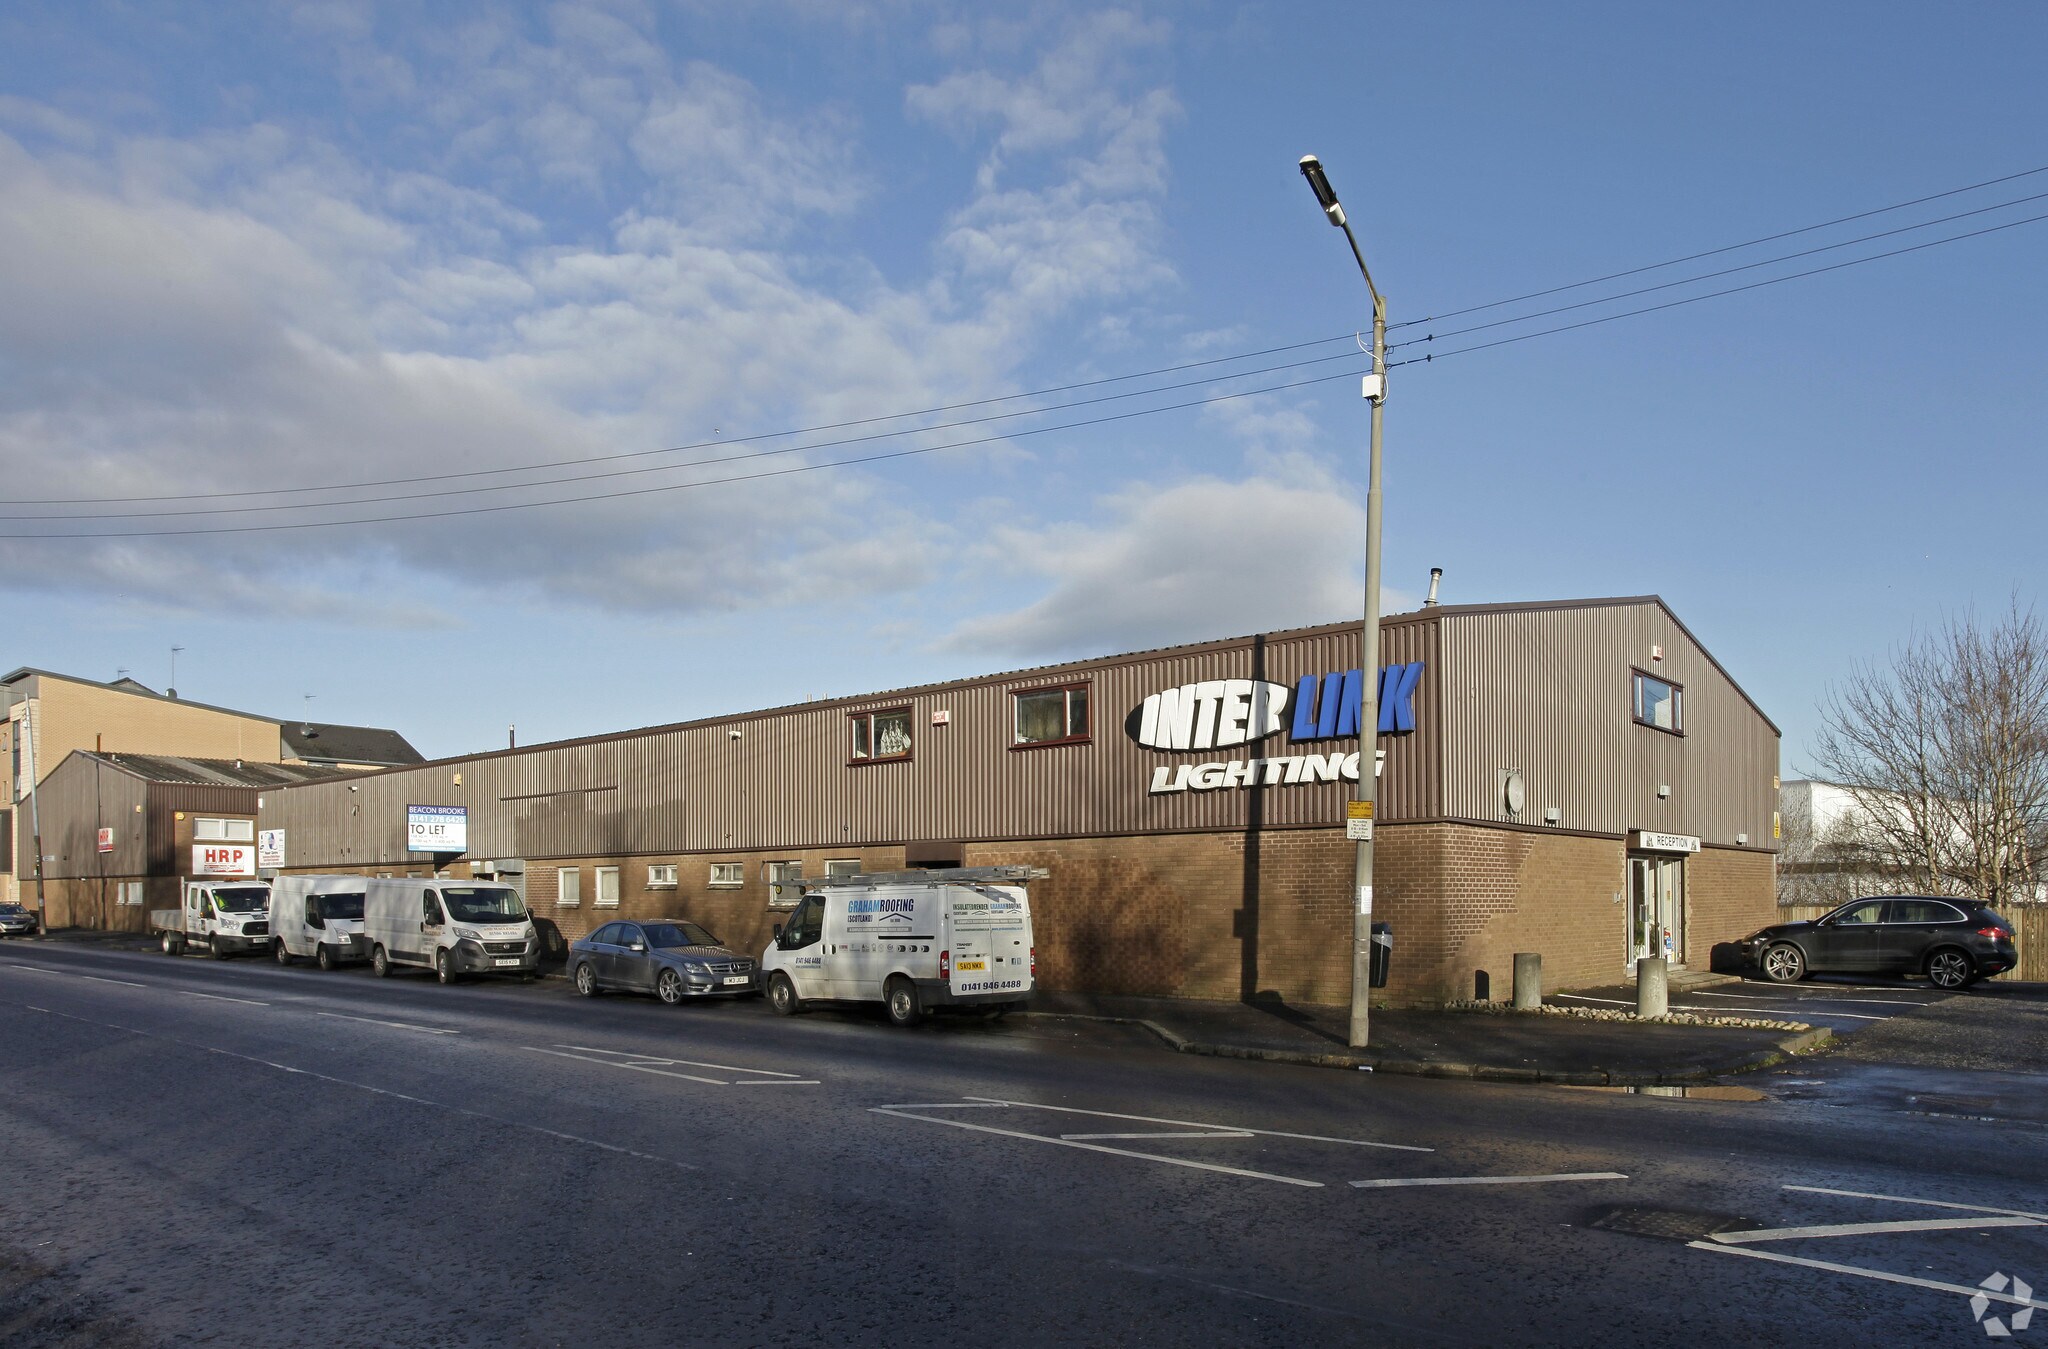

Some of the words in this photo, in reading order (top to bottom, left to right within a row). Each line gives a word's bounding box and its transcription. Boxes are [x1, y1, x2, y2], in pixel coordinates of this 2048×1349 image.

[1138, 678, 1289, 750] INTER
[1291, 661, 1425, 741] LINK
[1150, 750, 1386, 792] LIGHTING
[408, 806, 437, 814] BEACON
[438, 807, 465, 815] BROOKE
[446, 816, 465, 824] 6420
[410, 824, 425, 834] TO
[429, 825, 445, 835] LET
[1657, 835, 1688, 848] RECEPTION
[205, 849, 243, 863] HRP
[961, 983, 981, 991] 0141
[983, 981, 999, 990] 946
[1001, 980, 1022, 989] 4488
